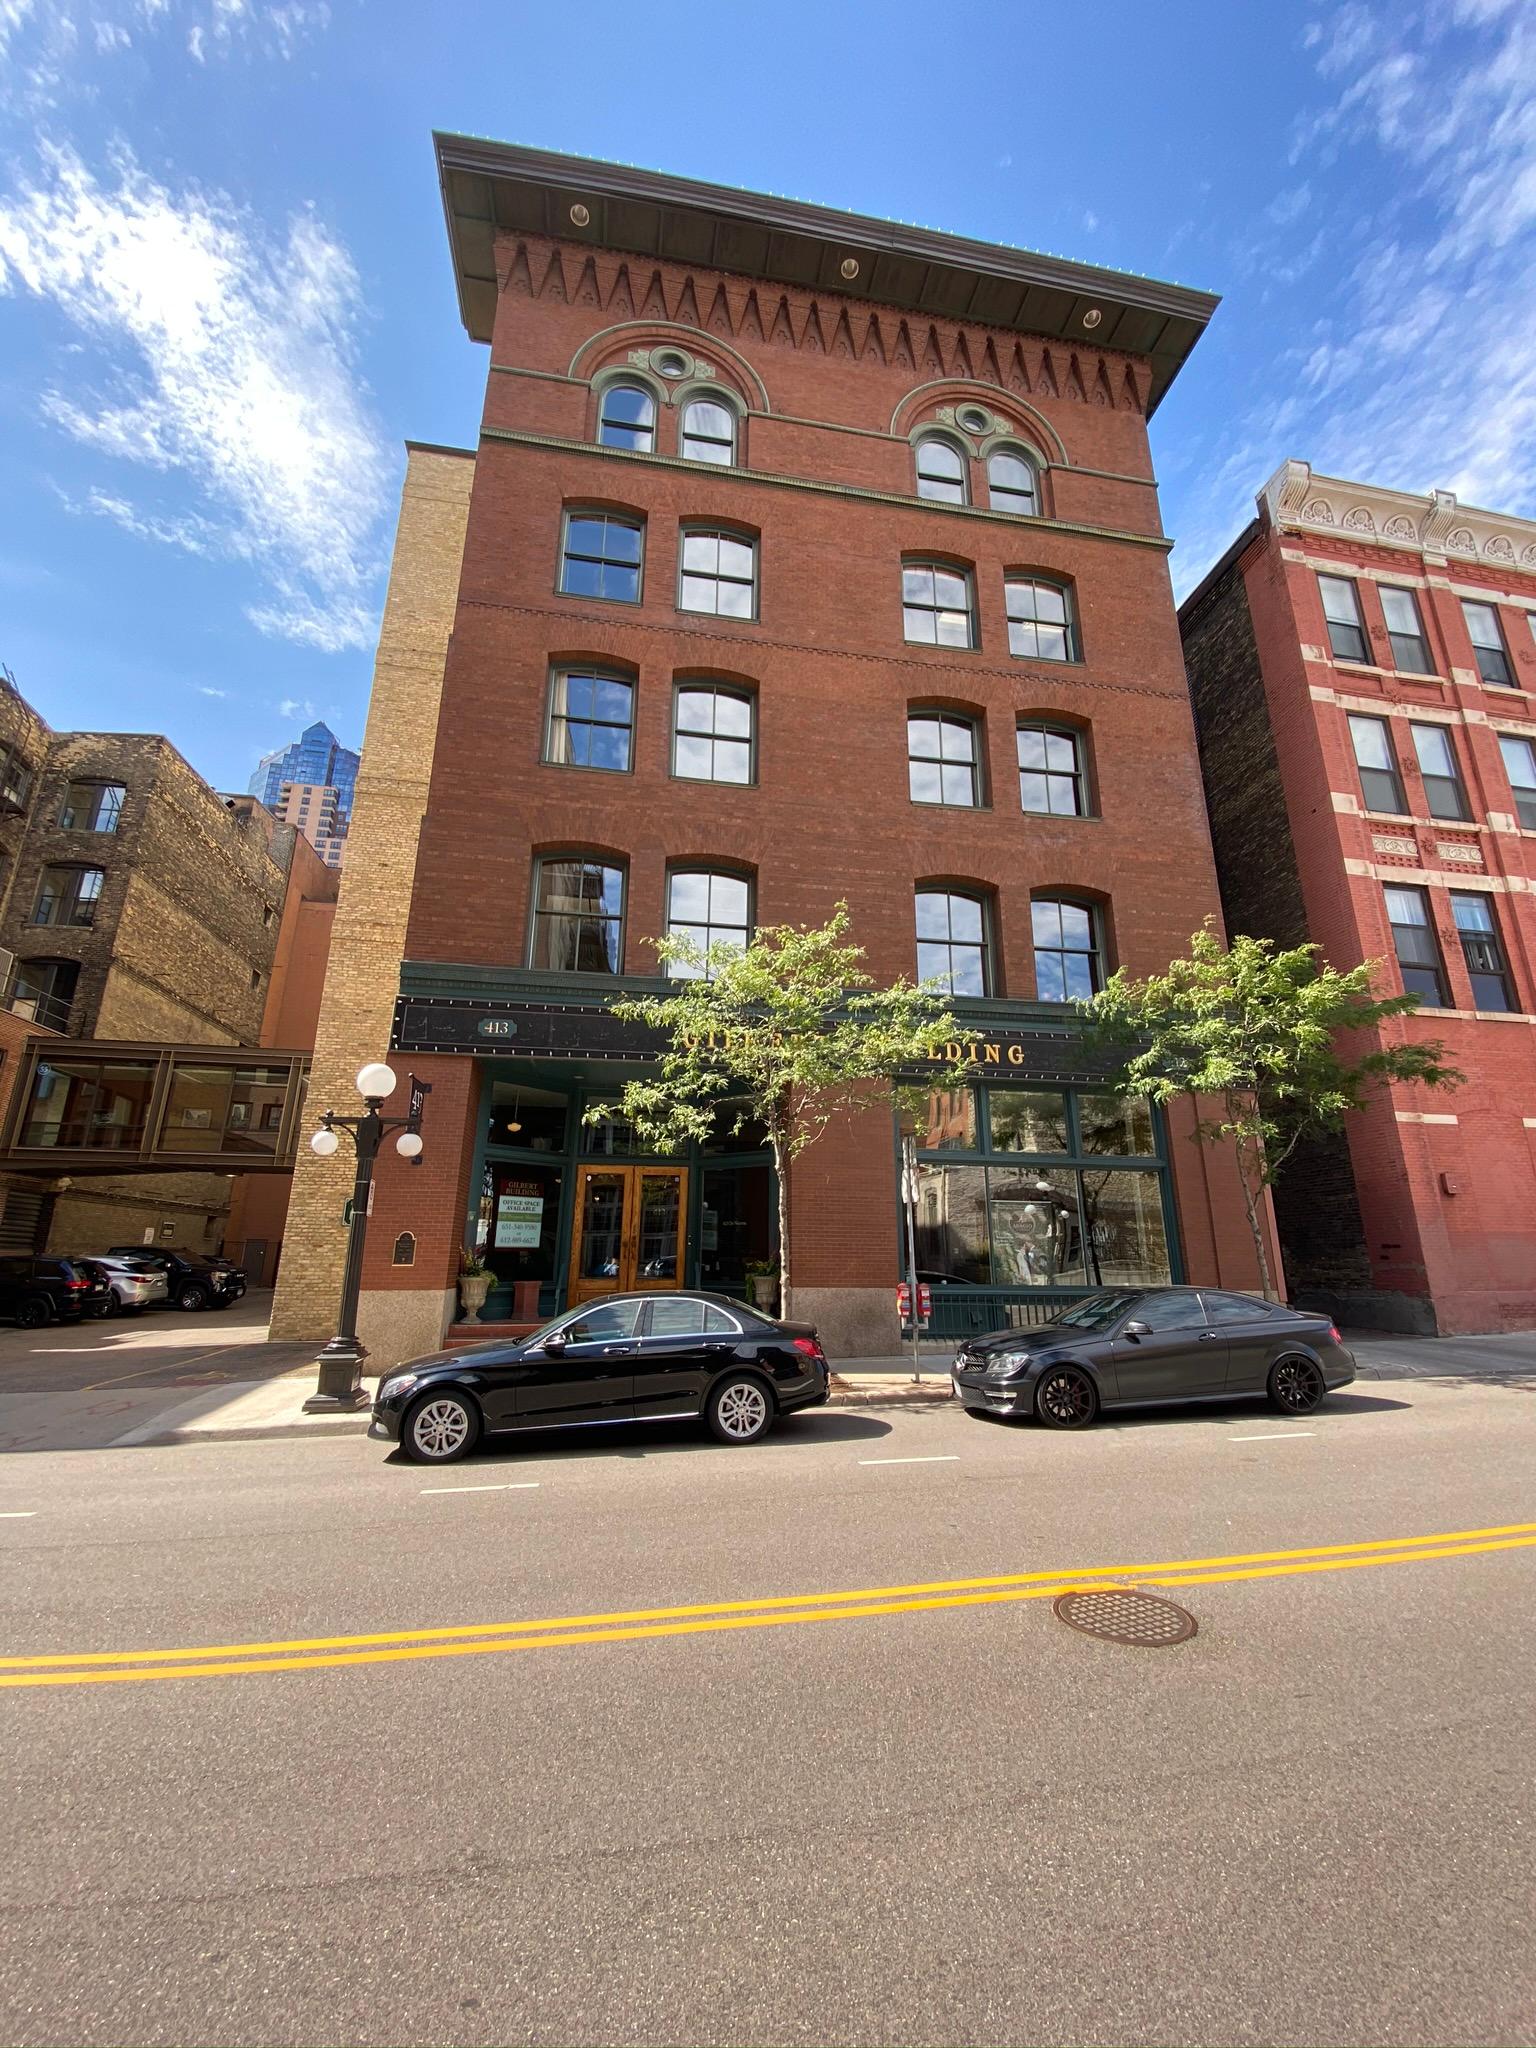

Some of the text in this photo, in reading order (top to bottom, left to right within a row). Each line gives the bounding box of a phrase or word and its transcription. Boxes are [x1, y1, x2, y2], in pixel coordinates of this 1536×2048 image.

[484, 1021, 509, 1034] 413
[508, 1181, 538, 1190] GILBERT
[505, 1188, 540, 1196] BUILDING
